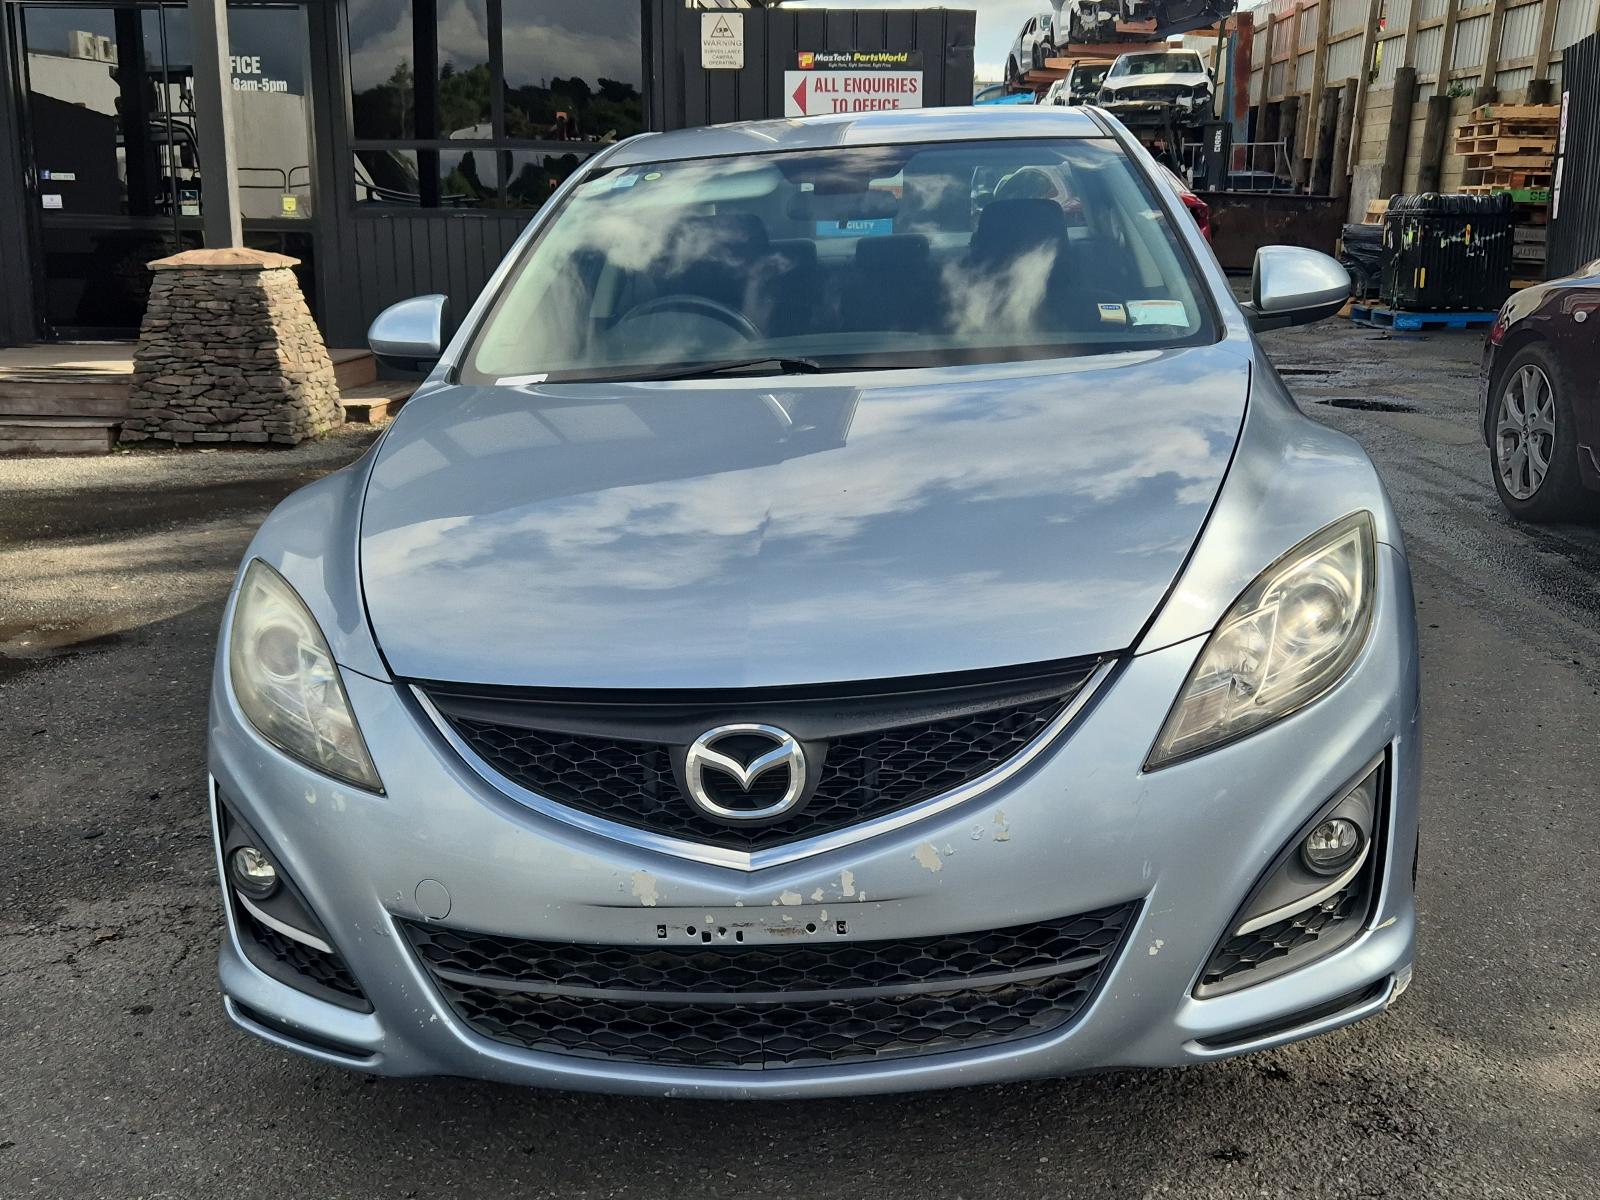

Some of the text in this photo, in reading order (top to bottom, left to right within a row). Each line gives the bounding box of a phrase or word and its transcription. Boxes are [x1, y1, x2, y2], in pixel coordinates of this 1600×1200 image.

[853, 52, 908, 62] PartsWorld
[229, 56, 262, 74] FICE
[232, 78, 288, 92] 8am-5pm
[814, 77, 918, 94] ALL ENQUIRIES
[831, 98, 900, 113] TO OFFICE
